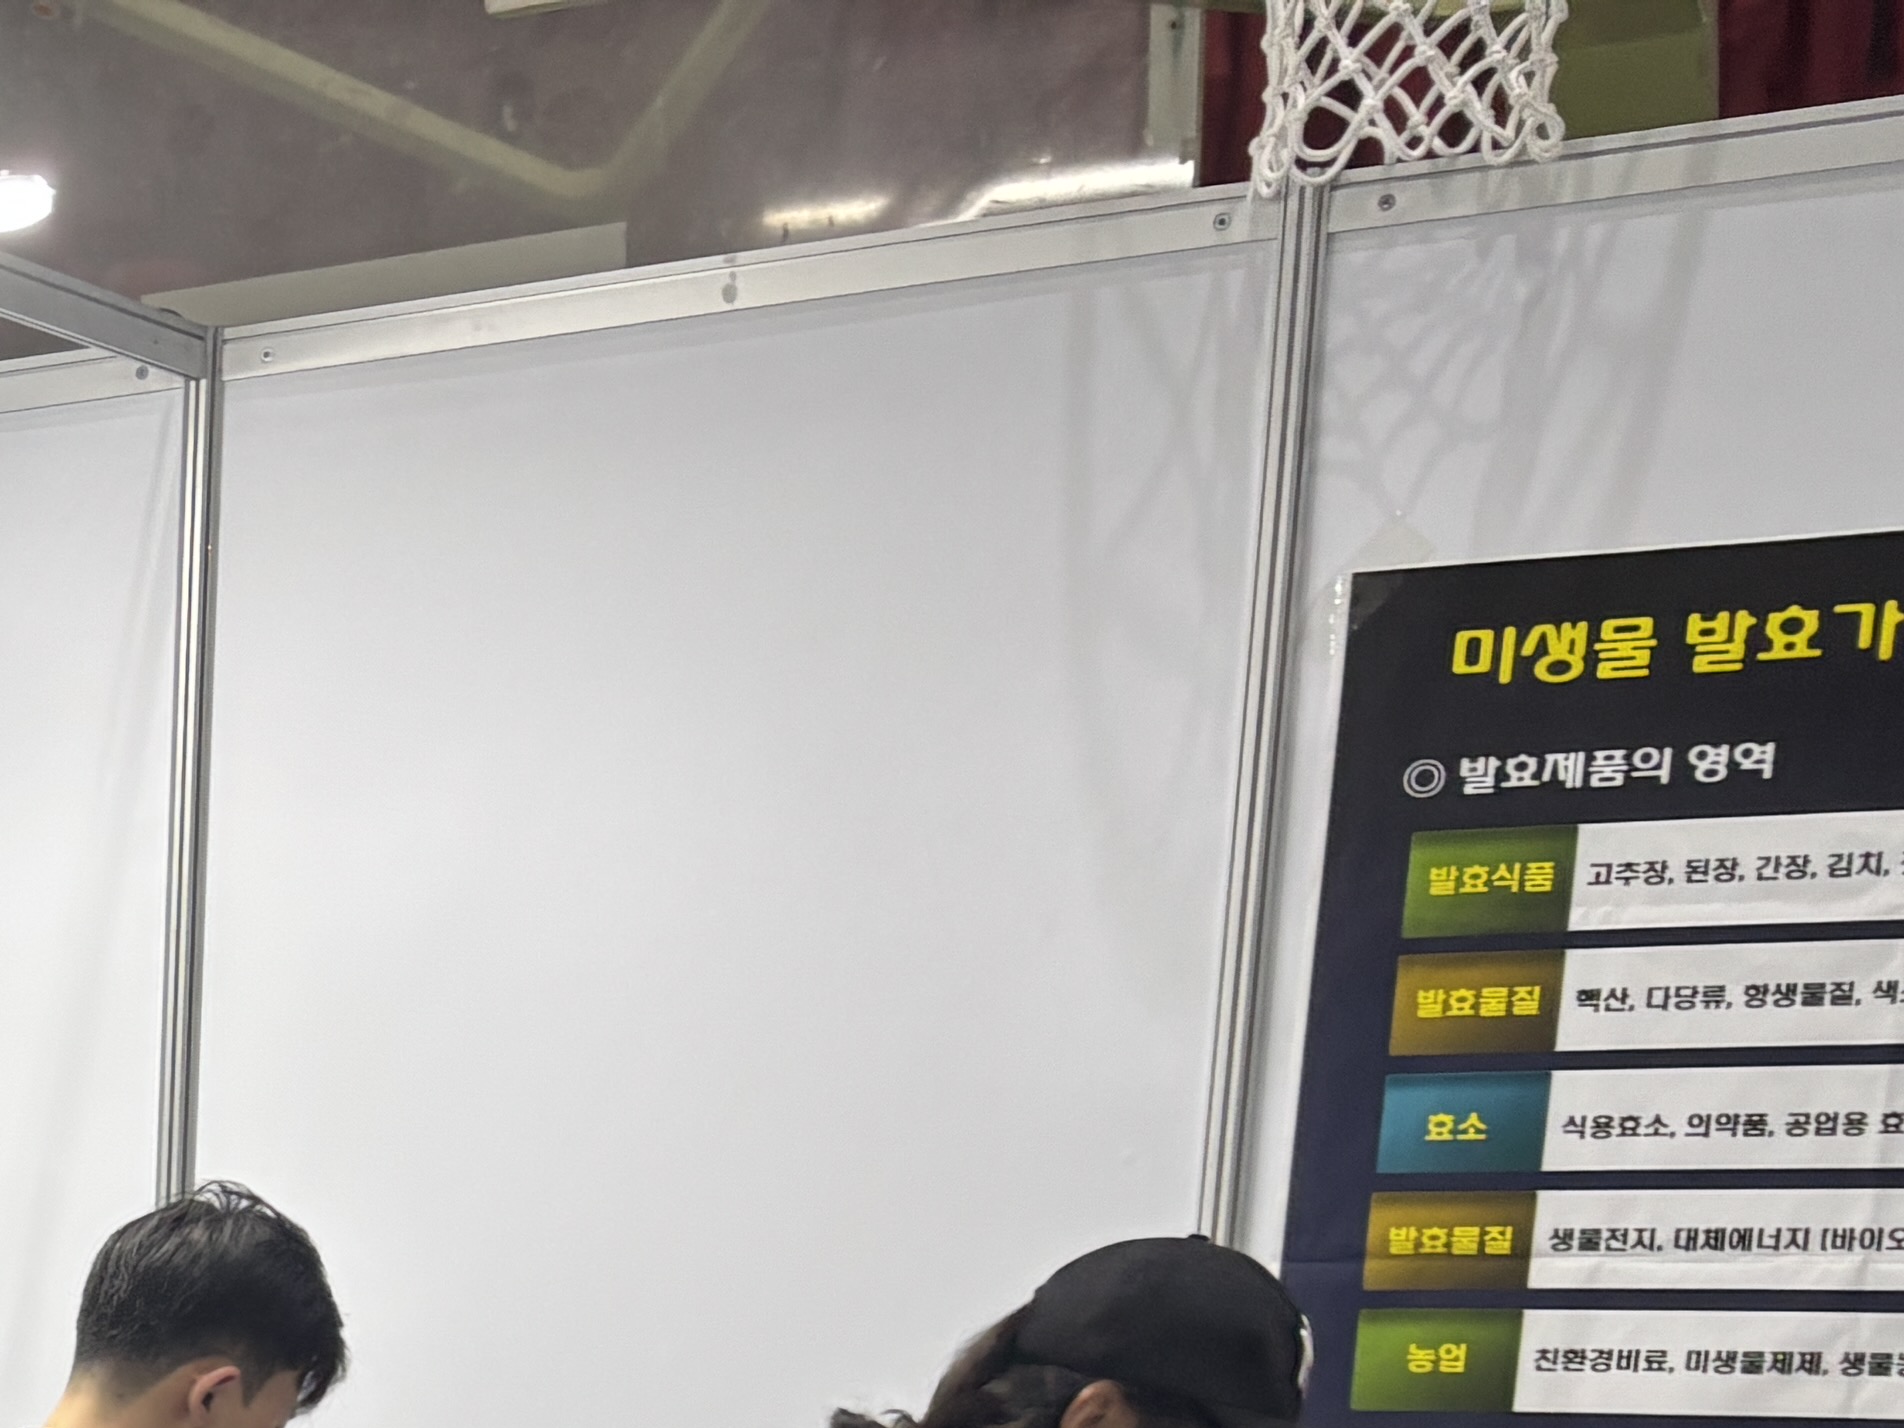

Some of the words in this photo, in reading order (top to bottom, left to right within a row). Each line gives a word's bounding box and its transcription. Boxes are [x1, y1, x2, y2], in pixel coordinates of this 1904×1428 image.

[1452, 617, 1657, 683] 미생물
[1460, 747, 1672, 794] 발효제품의
[1688, 743, 1775, 782] 영역
[1430, 862, 1554, 895] 발효식품
[1587, 860, 1674, 886] 고추장,
[1685, 857, 1745, 883] 된장,
[1756, 854, 1817, 881] 간장,
[1828, 851, 1889, 878] 김치,
[1417, 986, 1540, 1017] 발효물질
[1425, 1113, 1486, 1140] 효소
[1785, 1112, 1868, 1137] 공업용
[1389, 1227, 1512, 1254] 발효물질
[1407, 1344, 1466, 1372] 농업
